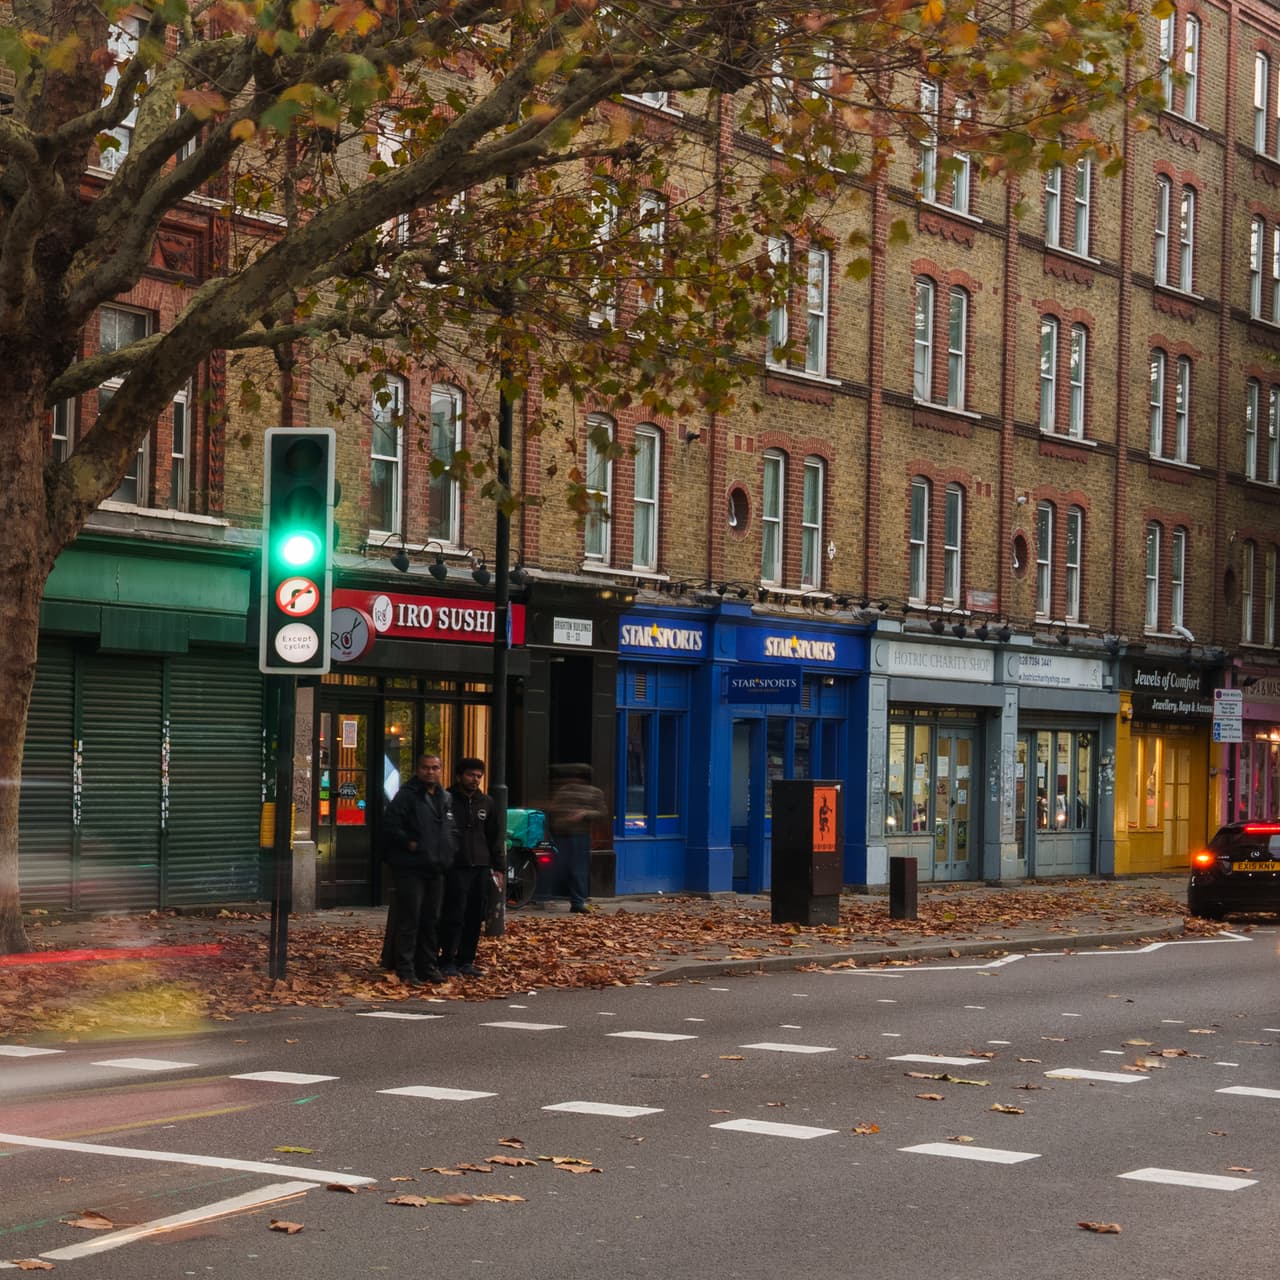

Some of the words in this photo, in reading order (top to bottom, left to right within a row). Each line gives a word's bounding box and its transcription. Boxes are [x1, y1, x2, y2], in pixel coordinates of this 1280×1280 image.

[398, 604, 433, 628] IRO
[438, 607, 495, 633] SUSHI
[284, 643, 310, 651] cycles
[331, 631, 352, 649] RO
[621, 624, 654, 647] STAR
[655, 627, 702, 651] SPORTS
[765, 636, 794, 658] STAR
[795, 639, 836, 661] SPORTS
[894, 650, 930, 666] HOTRIC
[931, 652, 967, 669] CHARITY
[968, 655, 990, 672] SHOP
[732, 679, 756, 688] STAR
[759, 679, 797, 688] SPORTS
[1135, 670, 1161, 687] Jewels
[1161, 672, 1171, 691] of
[1171, 673, 1200, 693] Comfort
